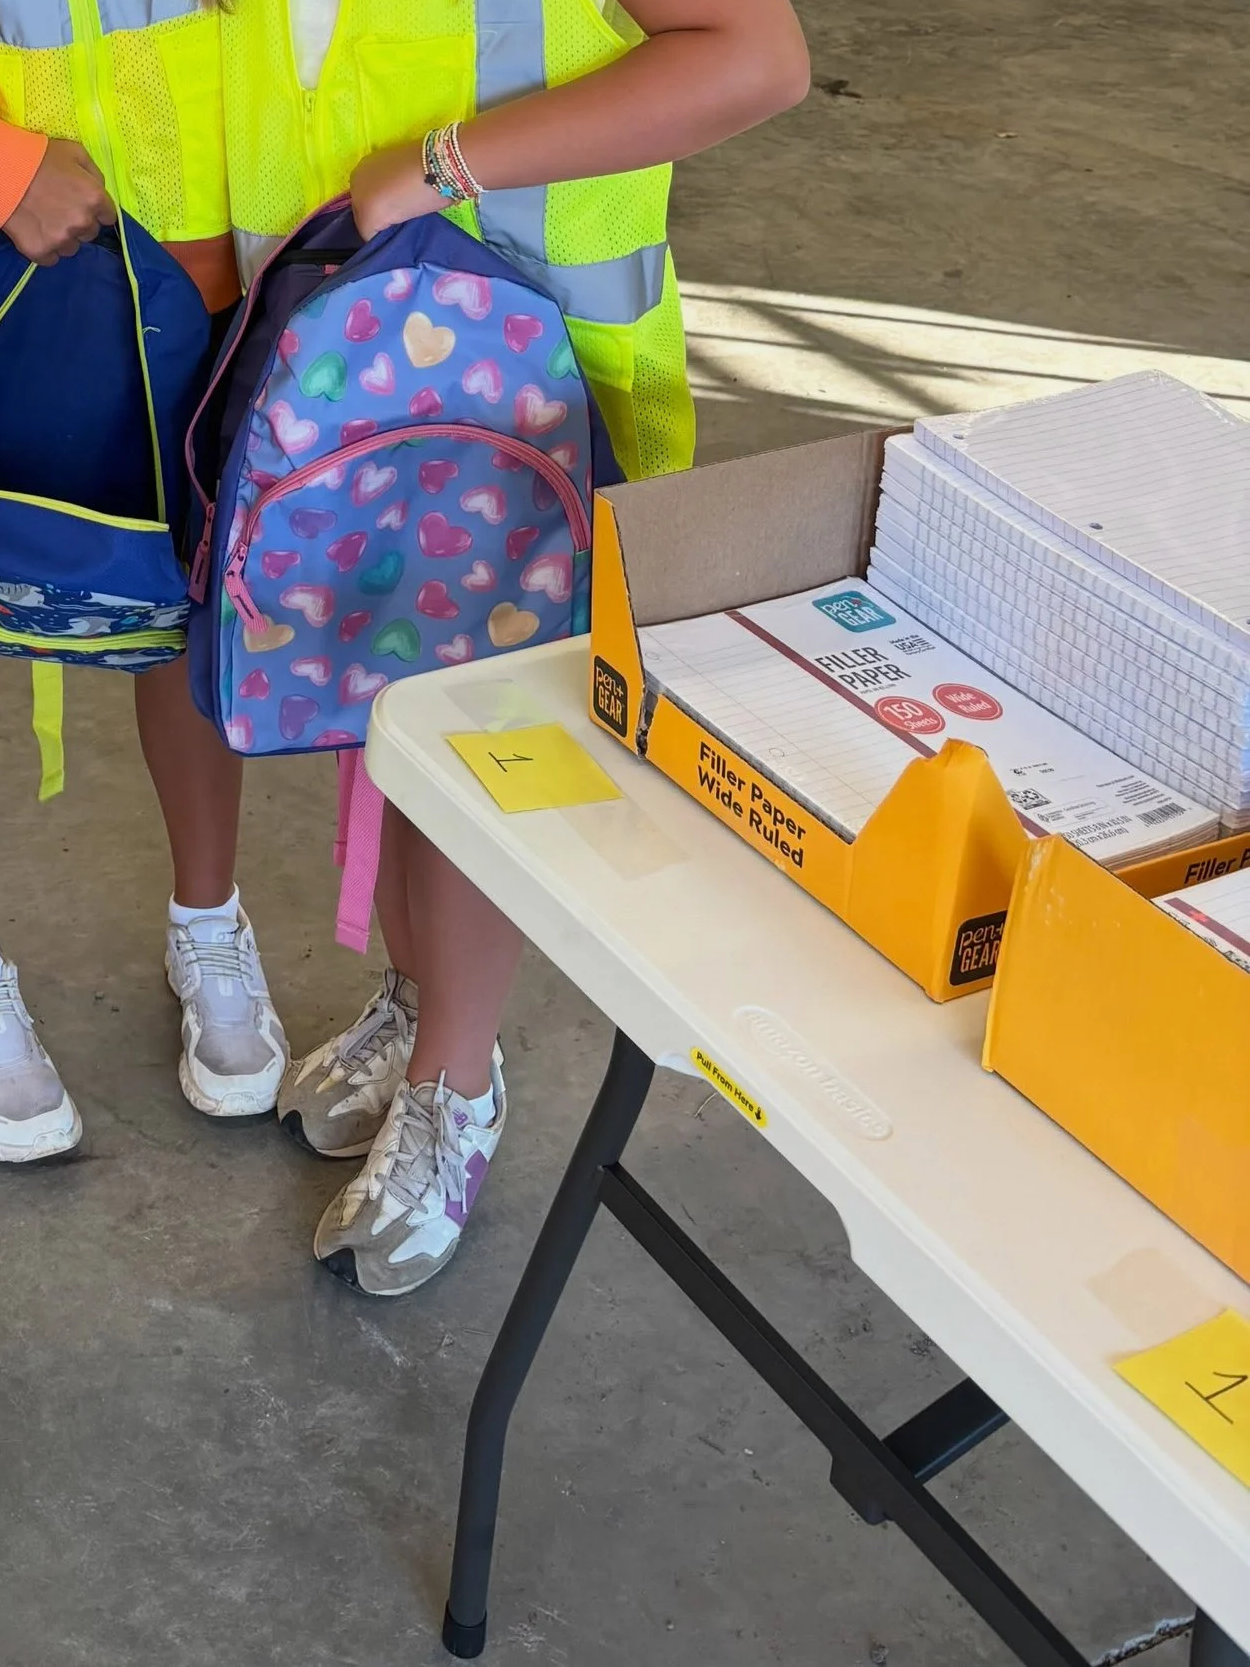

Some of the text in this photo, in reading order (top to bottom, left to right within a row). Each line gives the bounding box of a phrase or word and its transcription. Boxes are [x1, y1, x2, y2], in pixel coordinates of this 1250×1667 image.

[838, 606, 884, 626] GEAR
[814, 647, 889, 673] FILLER
[838, 664, 912, 690] PAPER
[598, 685, 623, 726] GEAR
[945, 692, 977, 704] Wide
[958, 699, 992, 714] Ruled
[883, 702, 924, 721] 150
[904, 717, 938, 730] Sheets
[488, 752, 534, 773] 1
[700, 741, 806, 840] Filler Paper
[698, 764, 804, 869] Wide Ruled
[1184, 857, 1238, 884] Filler
[960, 940, 1000, 973] GEAR
[696, 1051, 754, 1112] Pull From Here
[1184, 1371, 1249, 1426] 1
